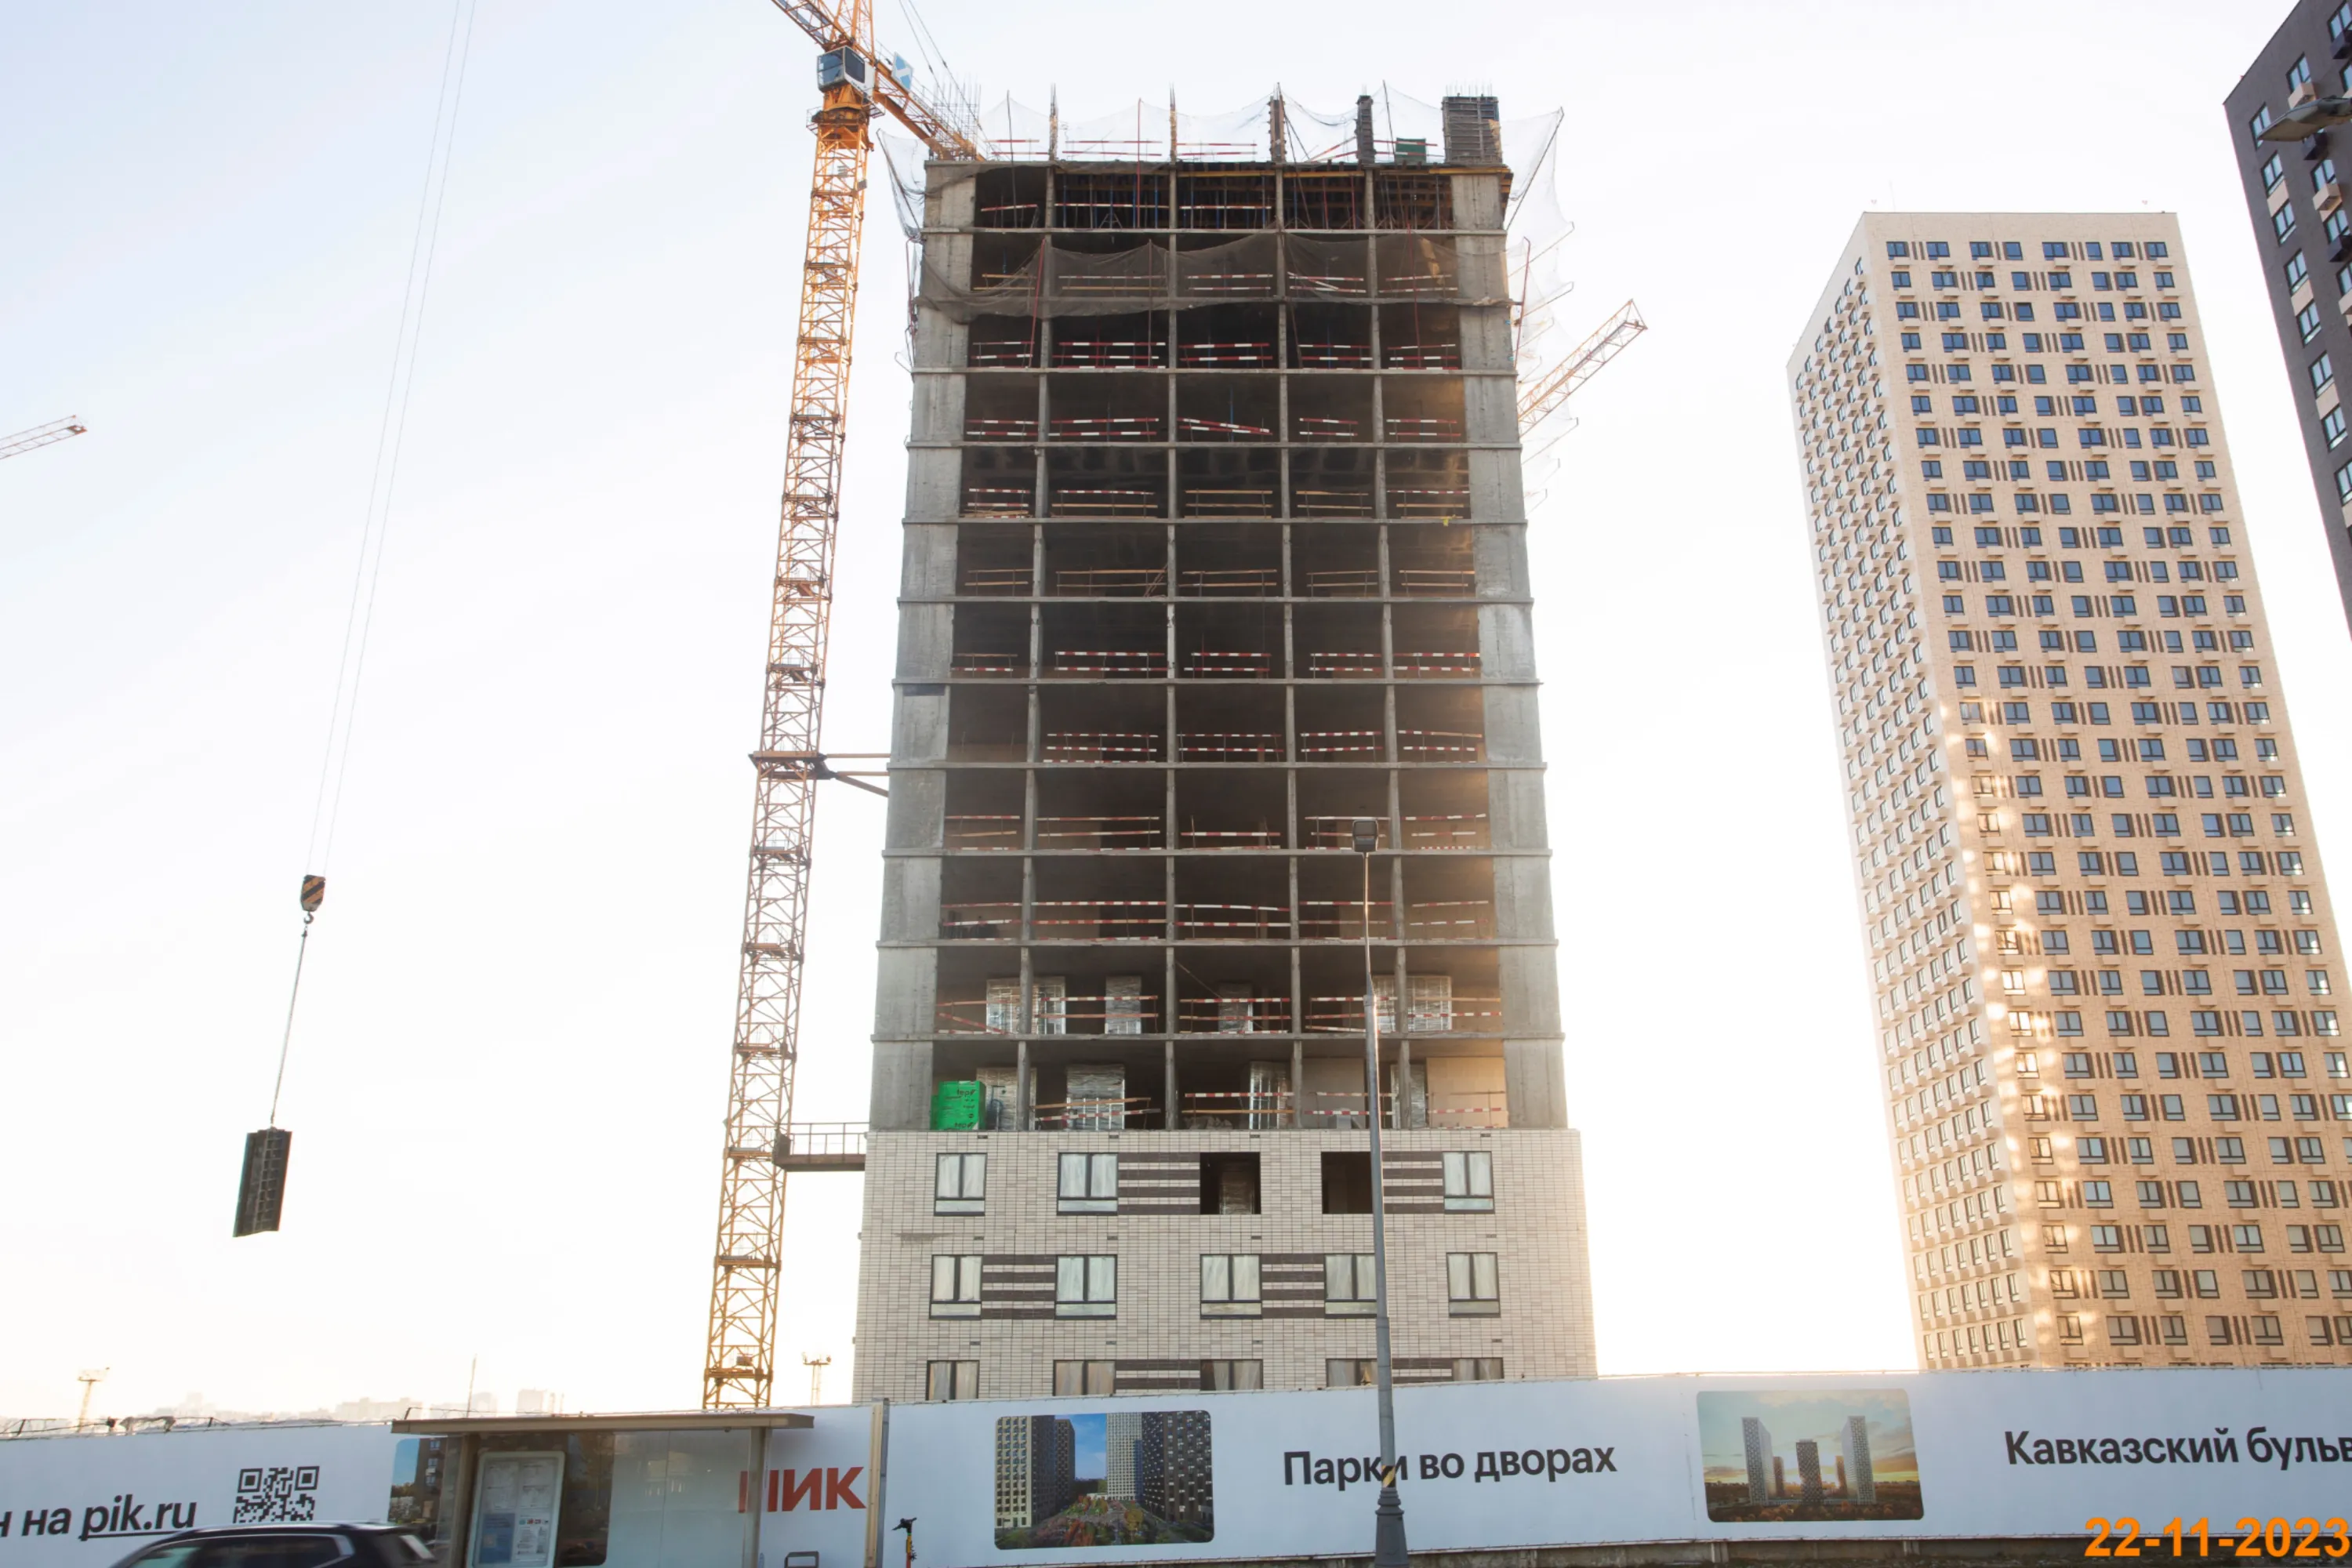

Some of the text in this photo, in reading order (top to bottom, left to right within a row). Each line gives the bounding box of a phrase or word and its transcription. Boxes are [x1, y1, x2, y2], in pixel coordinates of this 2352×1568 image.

[1419, 1452, 1465, 1479] во
[1474, 1446, 1617, 1483] дворах
[2005, 1427, 2239, 1465] Кавказский
[21, 1507, 72, 1537] на
[80, 1494, 197, 1541] pik.ru
